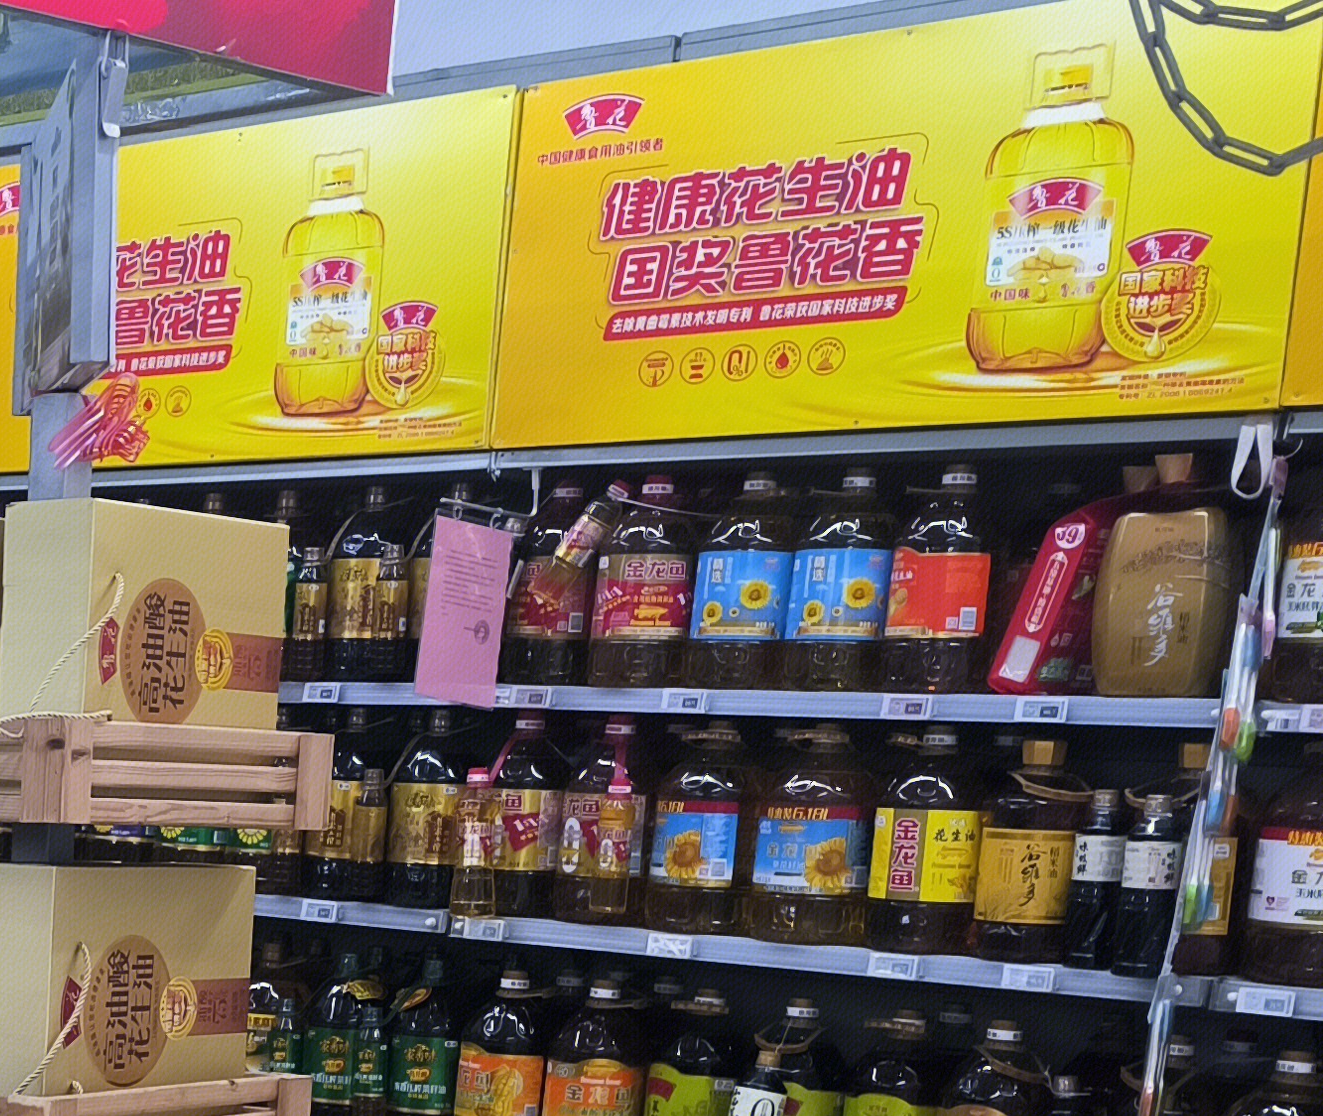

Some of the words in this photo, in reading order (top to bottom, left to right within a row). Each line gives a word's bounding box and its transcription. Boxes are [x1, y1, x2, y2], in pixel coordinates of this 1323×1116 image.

[537, 138, 665, 167] 中国健康食用油引领者
[600, 149, 915, 242] 健康花生油
[608, 216, 926, 308] 国奖鲁花香
[623, 558, 687, 582] 金龙鱼
[137, 591, 167, 715] 高油酸
[161, 598, 192, 711] 花生油
[890, 817, 922, 894] 金龙鱼
[102, 947, 131, 1069] 高油酸
[126, 952, 155, 1061] 花生油
